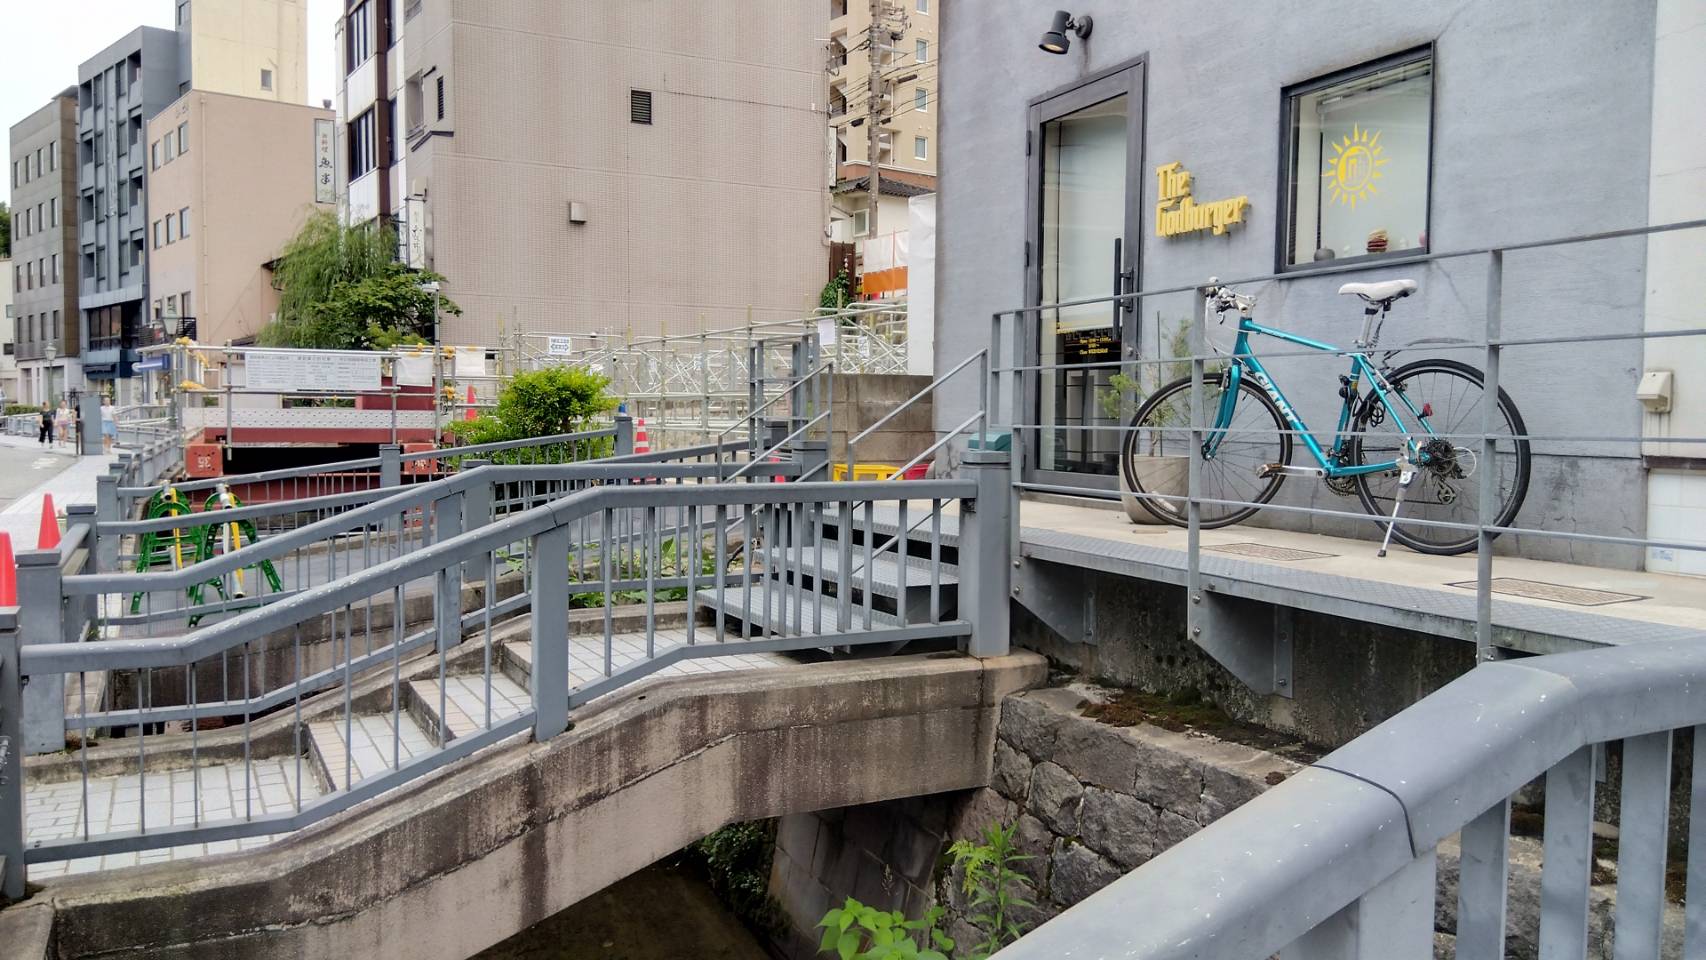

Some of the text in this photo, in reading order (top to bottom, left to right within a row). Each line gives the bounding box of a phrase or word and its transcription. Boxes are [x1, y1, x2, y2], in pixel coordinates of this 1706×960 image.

[1156, 161, 1190, 200] The
[1156, 196, 1249, 237] Godburger
[1255, 372, 1300, 423] GIANT
